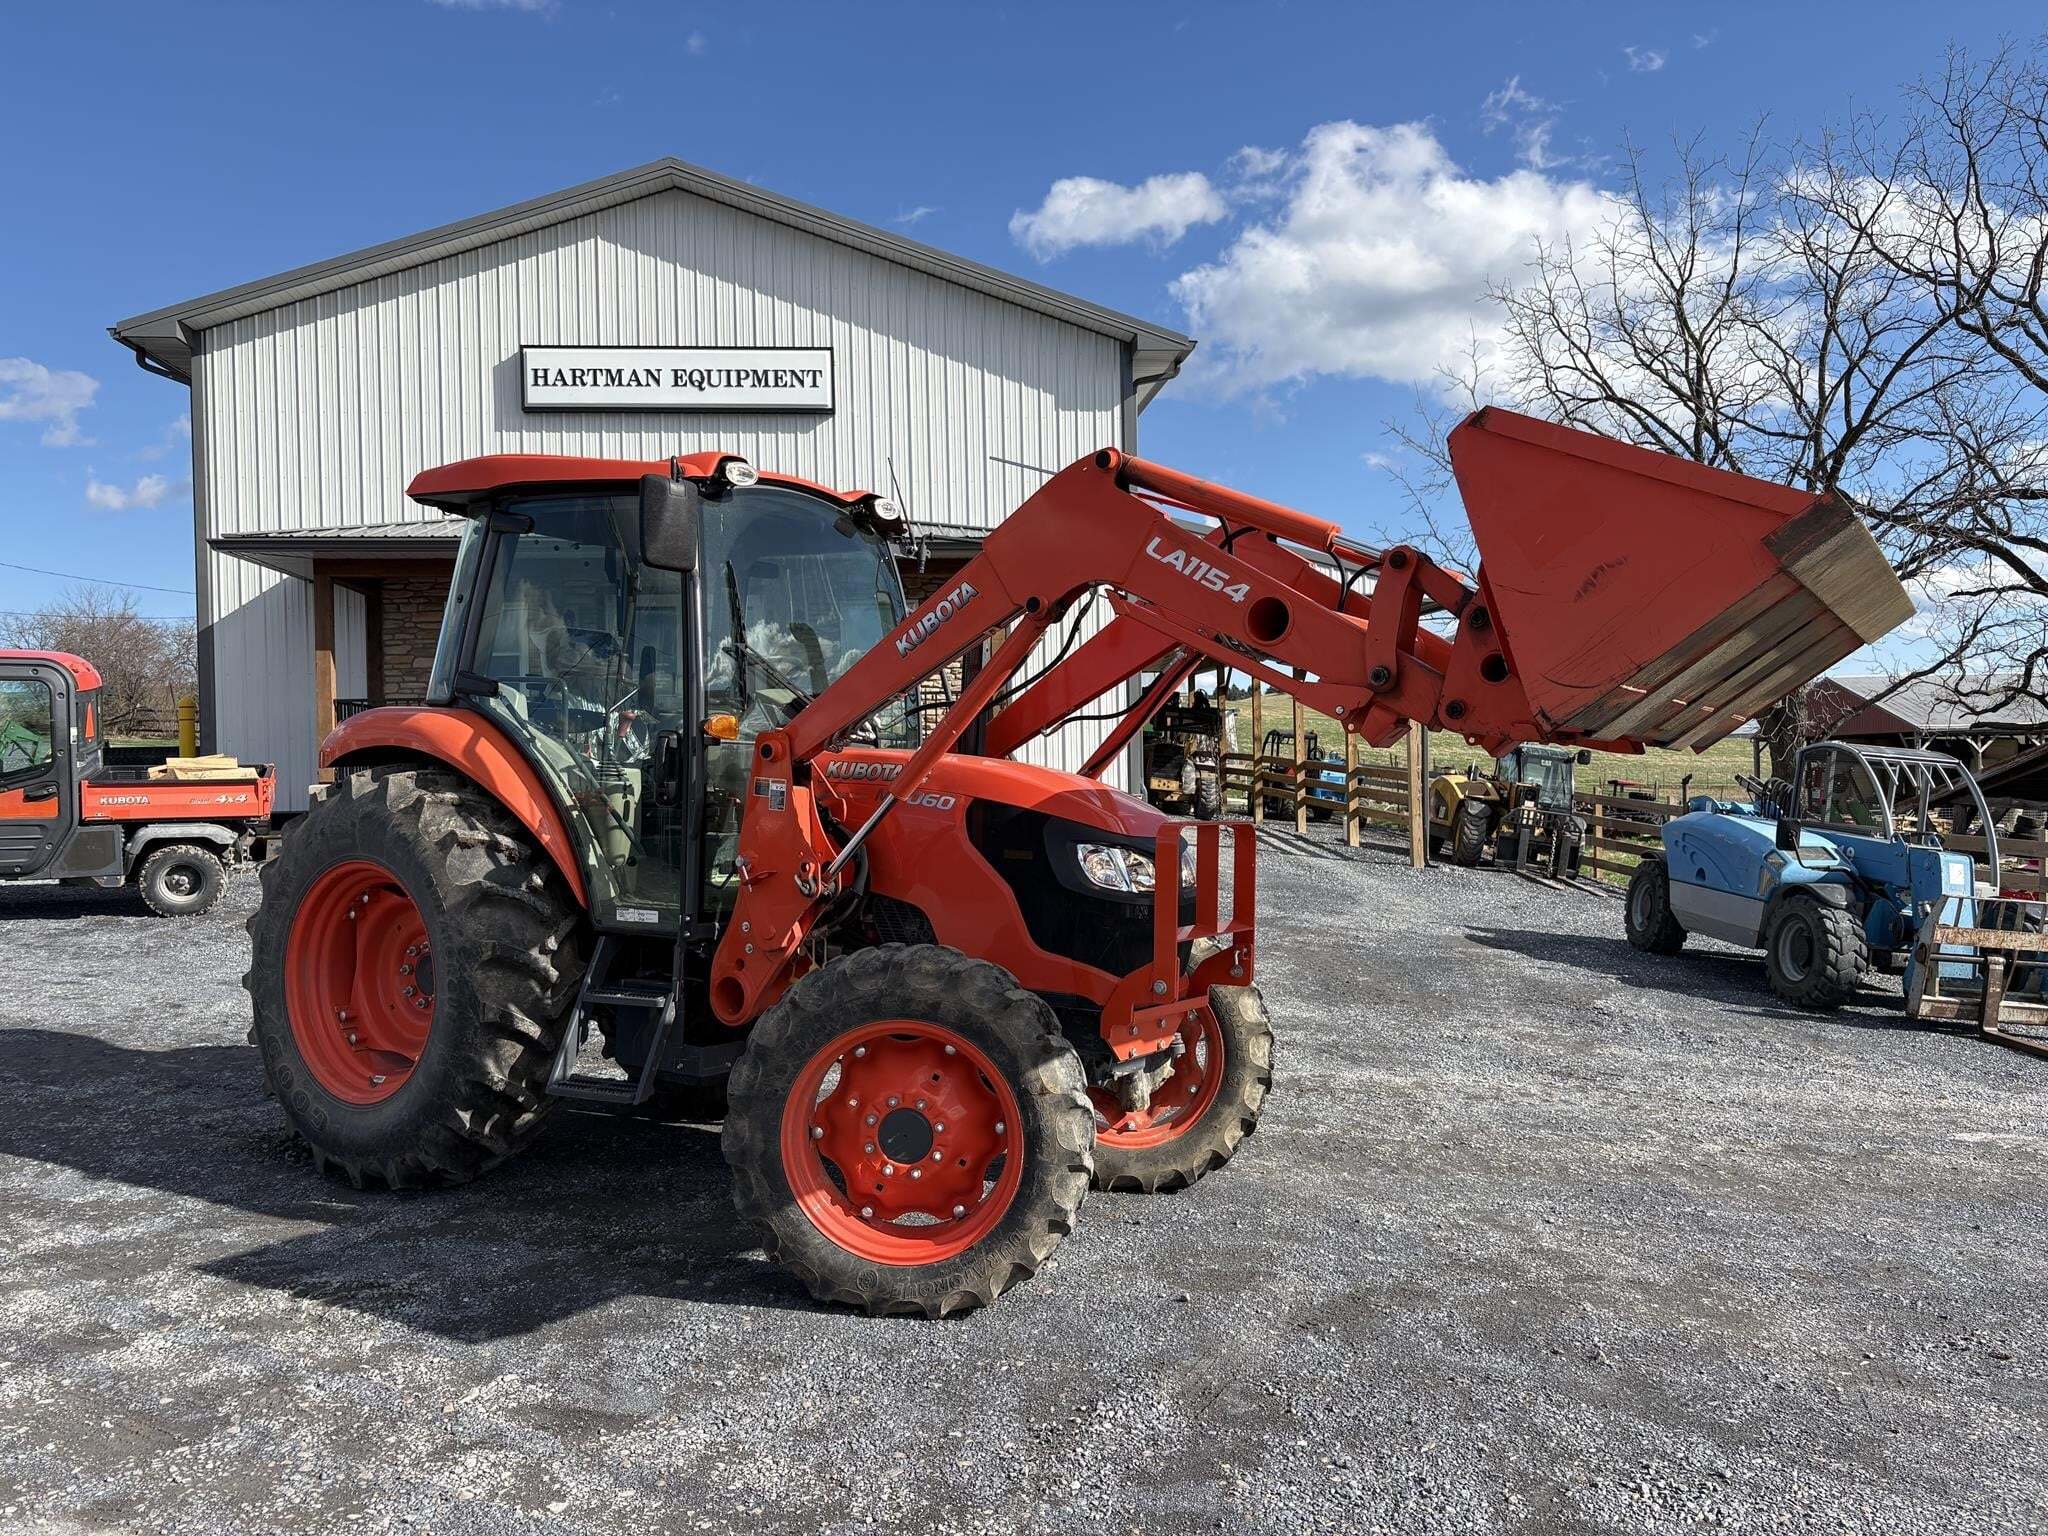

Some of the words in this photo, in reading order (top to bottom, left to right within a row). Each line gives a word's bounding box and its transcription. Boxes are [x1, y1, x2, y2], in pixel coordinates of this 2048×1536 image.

[530, 368, 662, 387] HARTMAN
[671, 369, 823, 391] EQUIPMENT
[1146, 536, 1250, 603] LA1154
[895, 581, 978, 657] KUBOTA
[100, 795, 150, 805] KUBOTA
[215, 794, 248, 805] 4x4
